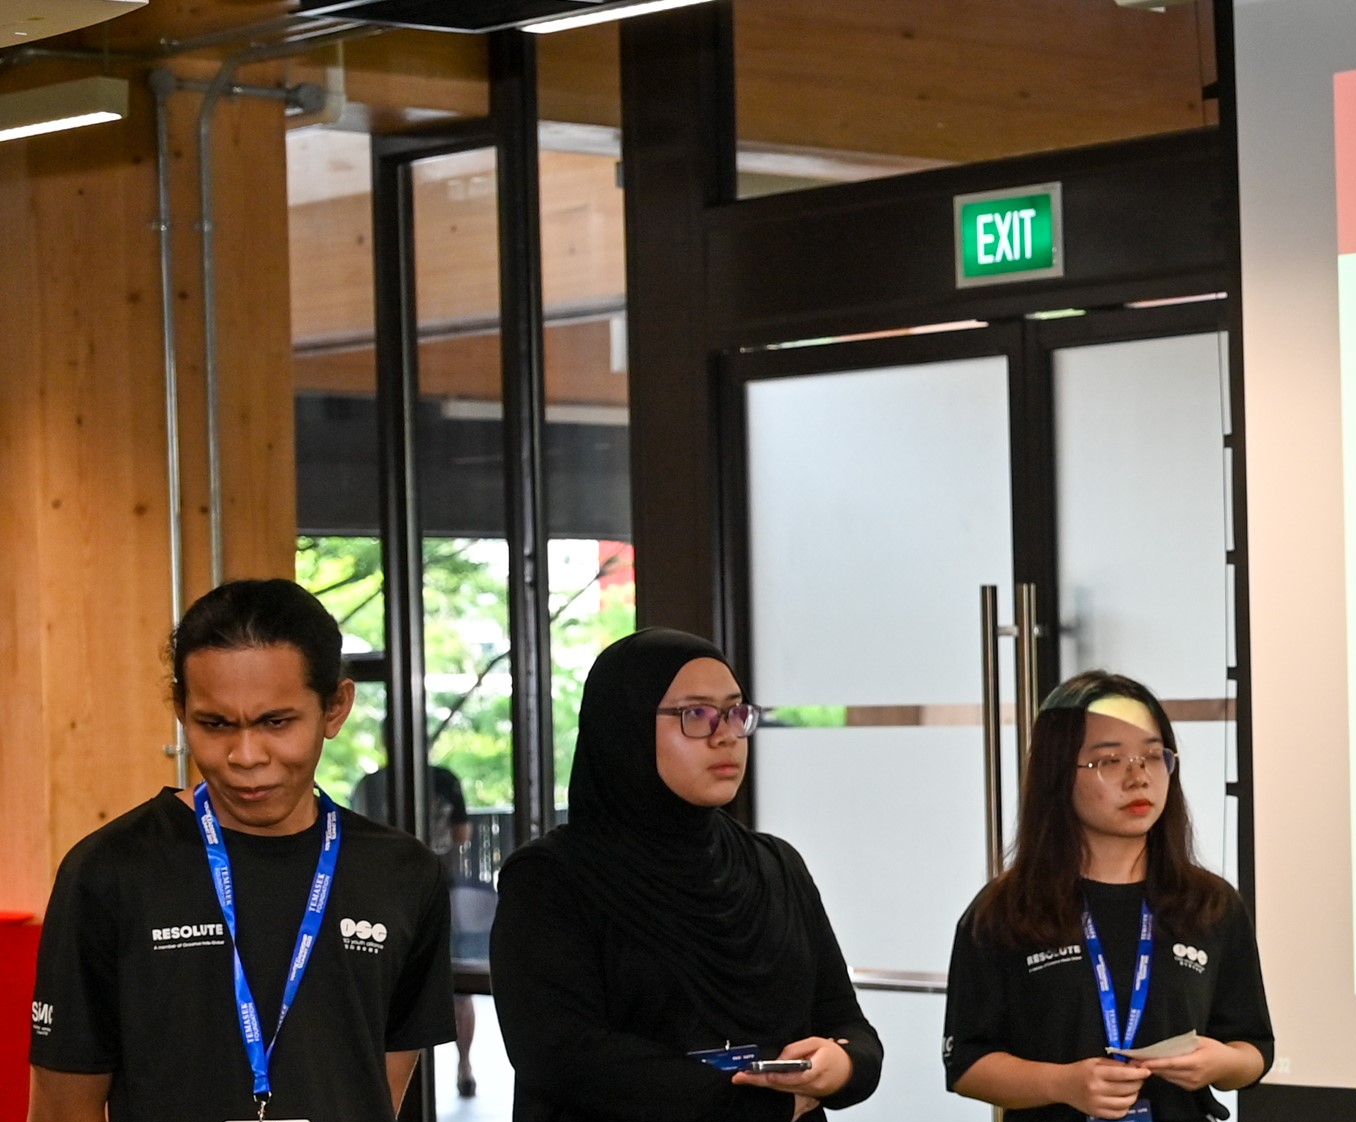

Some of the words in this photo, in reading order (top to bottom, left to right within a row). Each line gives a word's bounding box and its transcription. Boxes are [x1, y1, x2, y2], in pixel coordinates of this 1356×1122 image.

[976, 208, 1036, 265] EXIT
[309, 873, 325, 912] TEMASEK
[152, 924, 223, 941] RESOLUTE
